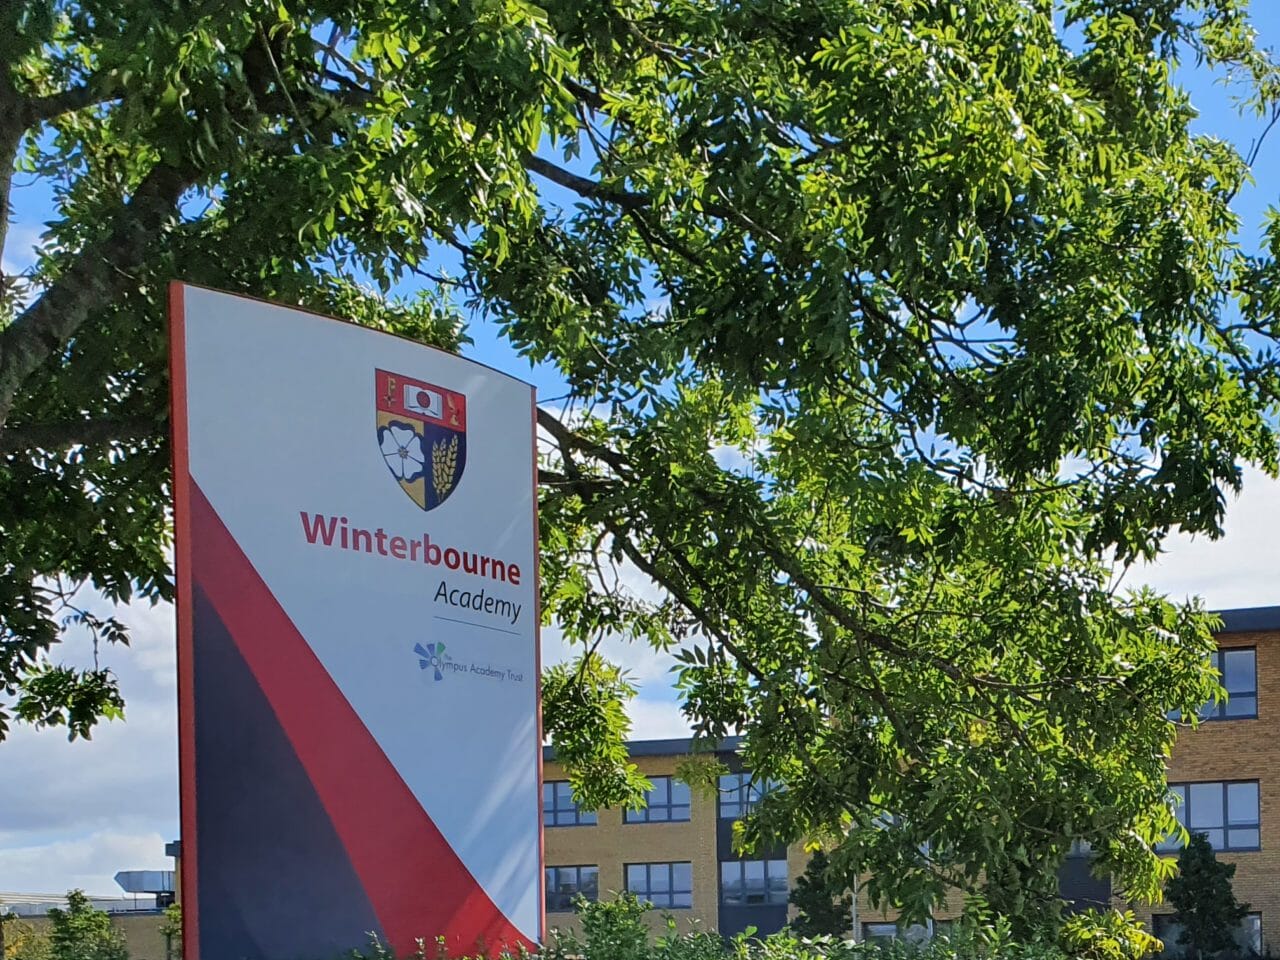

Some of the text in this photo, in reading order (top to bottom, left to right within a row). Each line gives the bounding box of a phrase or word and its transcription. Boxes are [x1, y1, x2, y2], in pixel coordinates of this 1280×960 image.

[300, 511, 521, 585] Winterbourne
[433, 580, 522, 625] Academy
[470, 664, 506, 680] Academy
[507, 669, 524, 681] Trust
